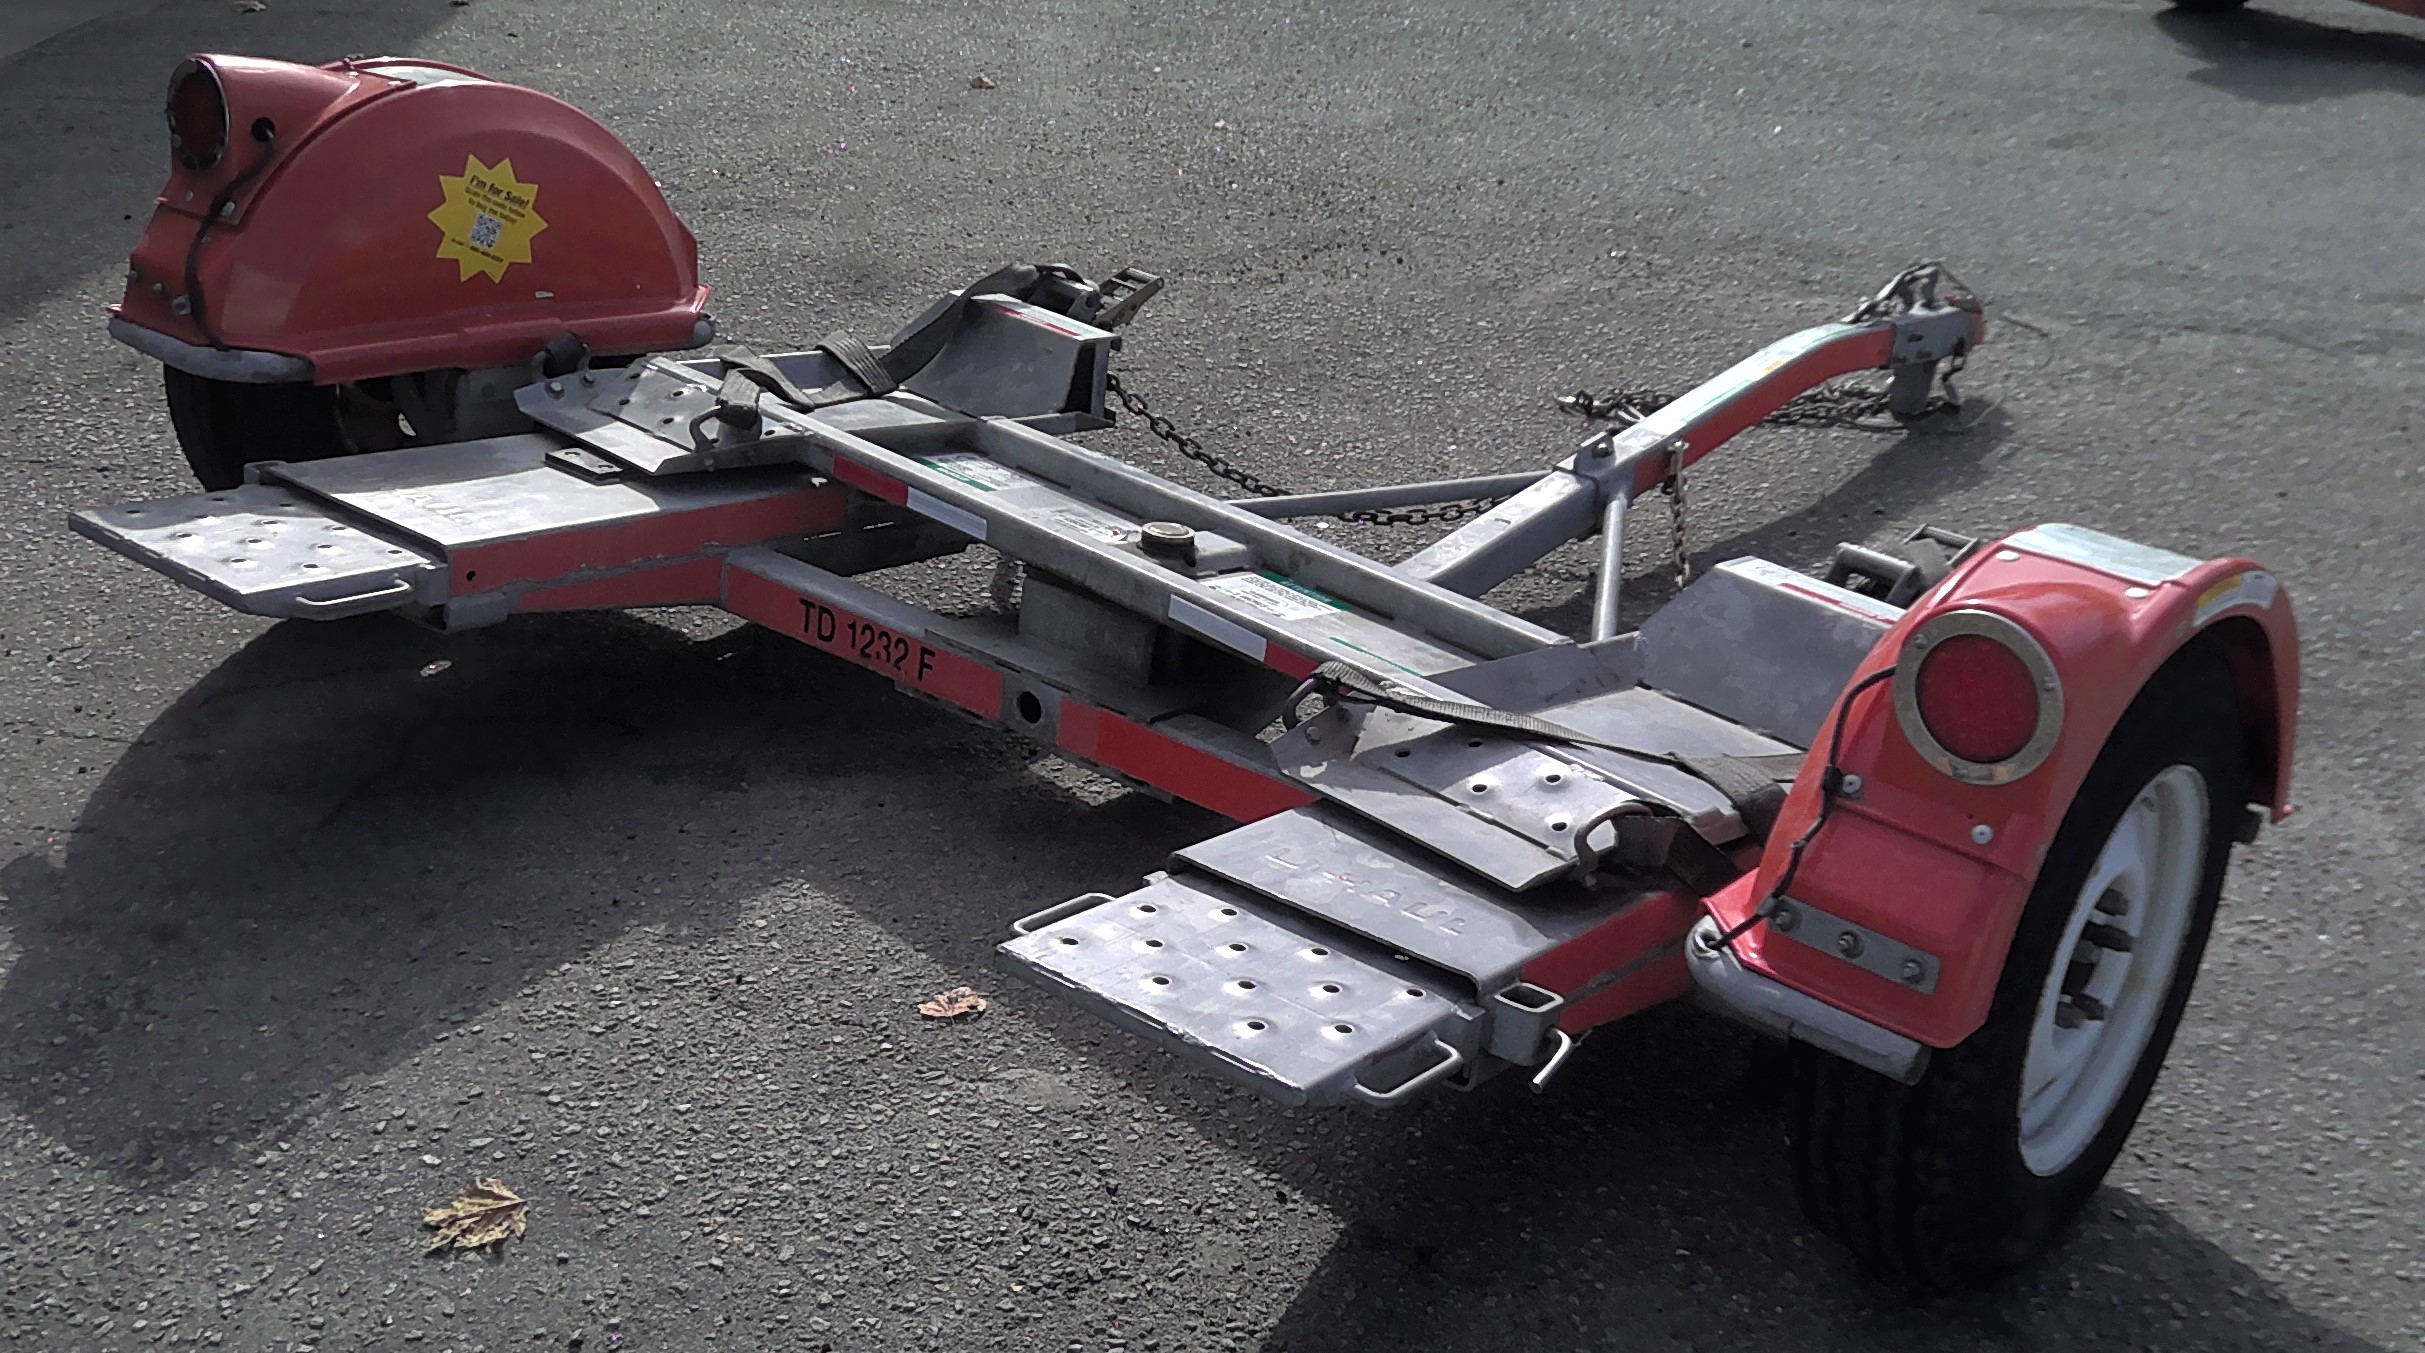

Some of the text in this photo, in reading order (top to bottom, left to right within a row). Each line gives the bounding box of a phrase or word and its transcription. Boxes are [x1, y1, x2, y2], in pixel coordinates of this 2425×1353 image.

[800, 598, 936, 681] TD 1232 F
